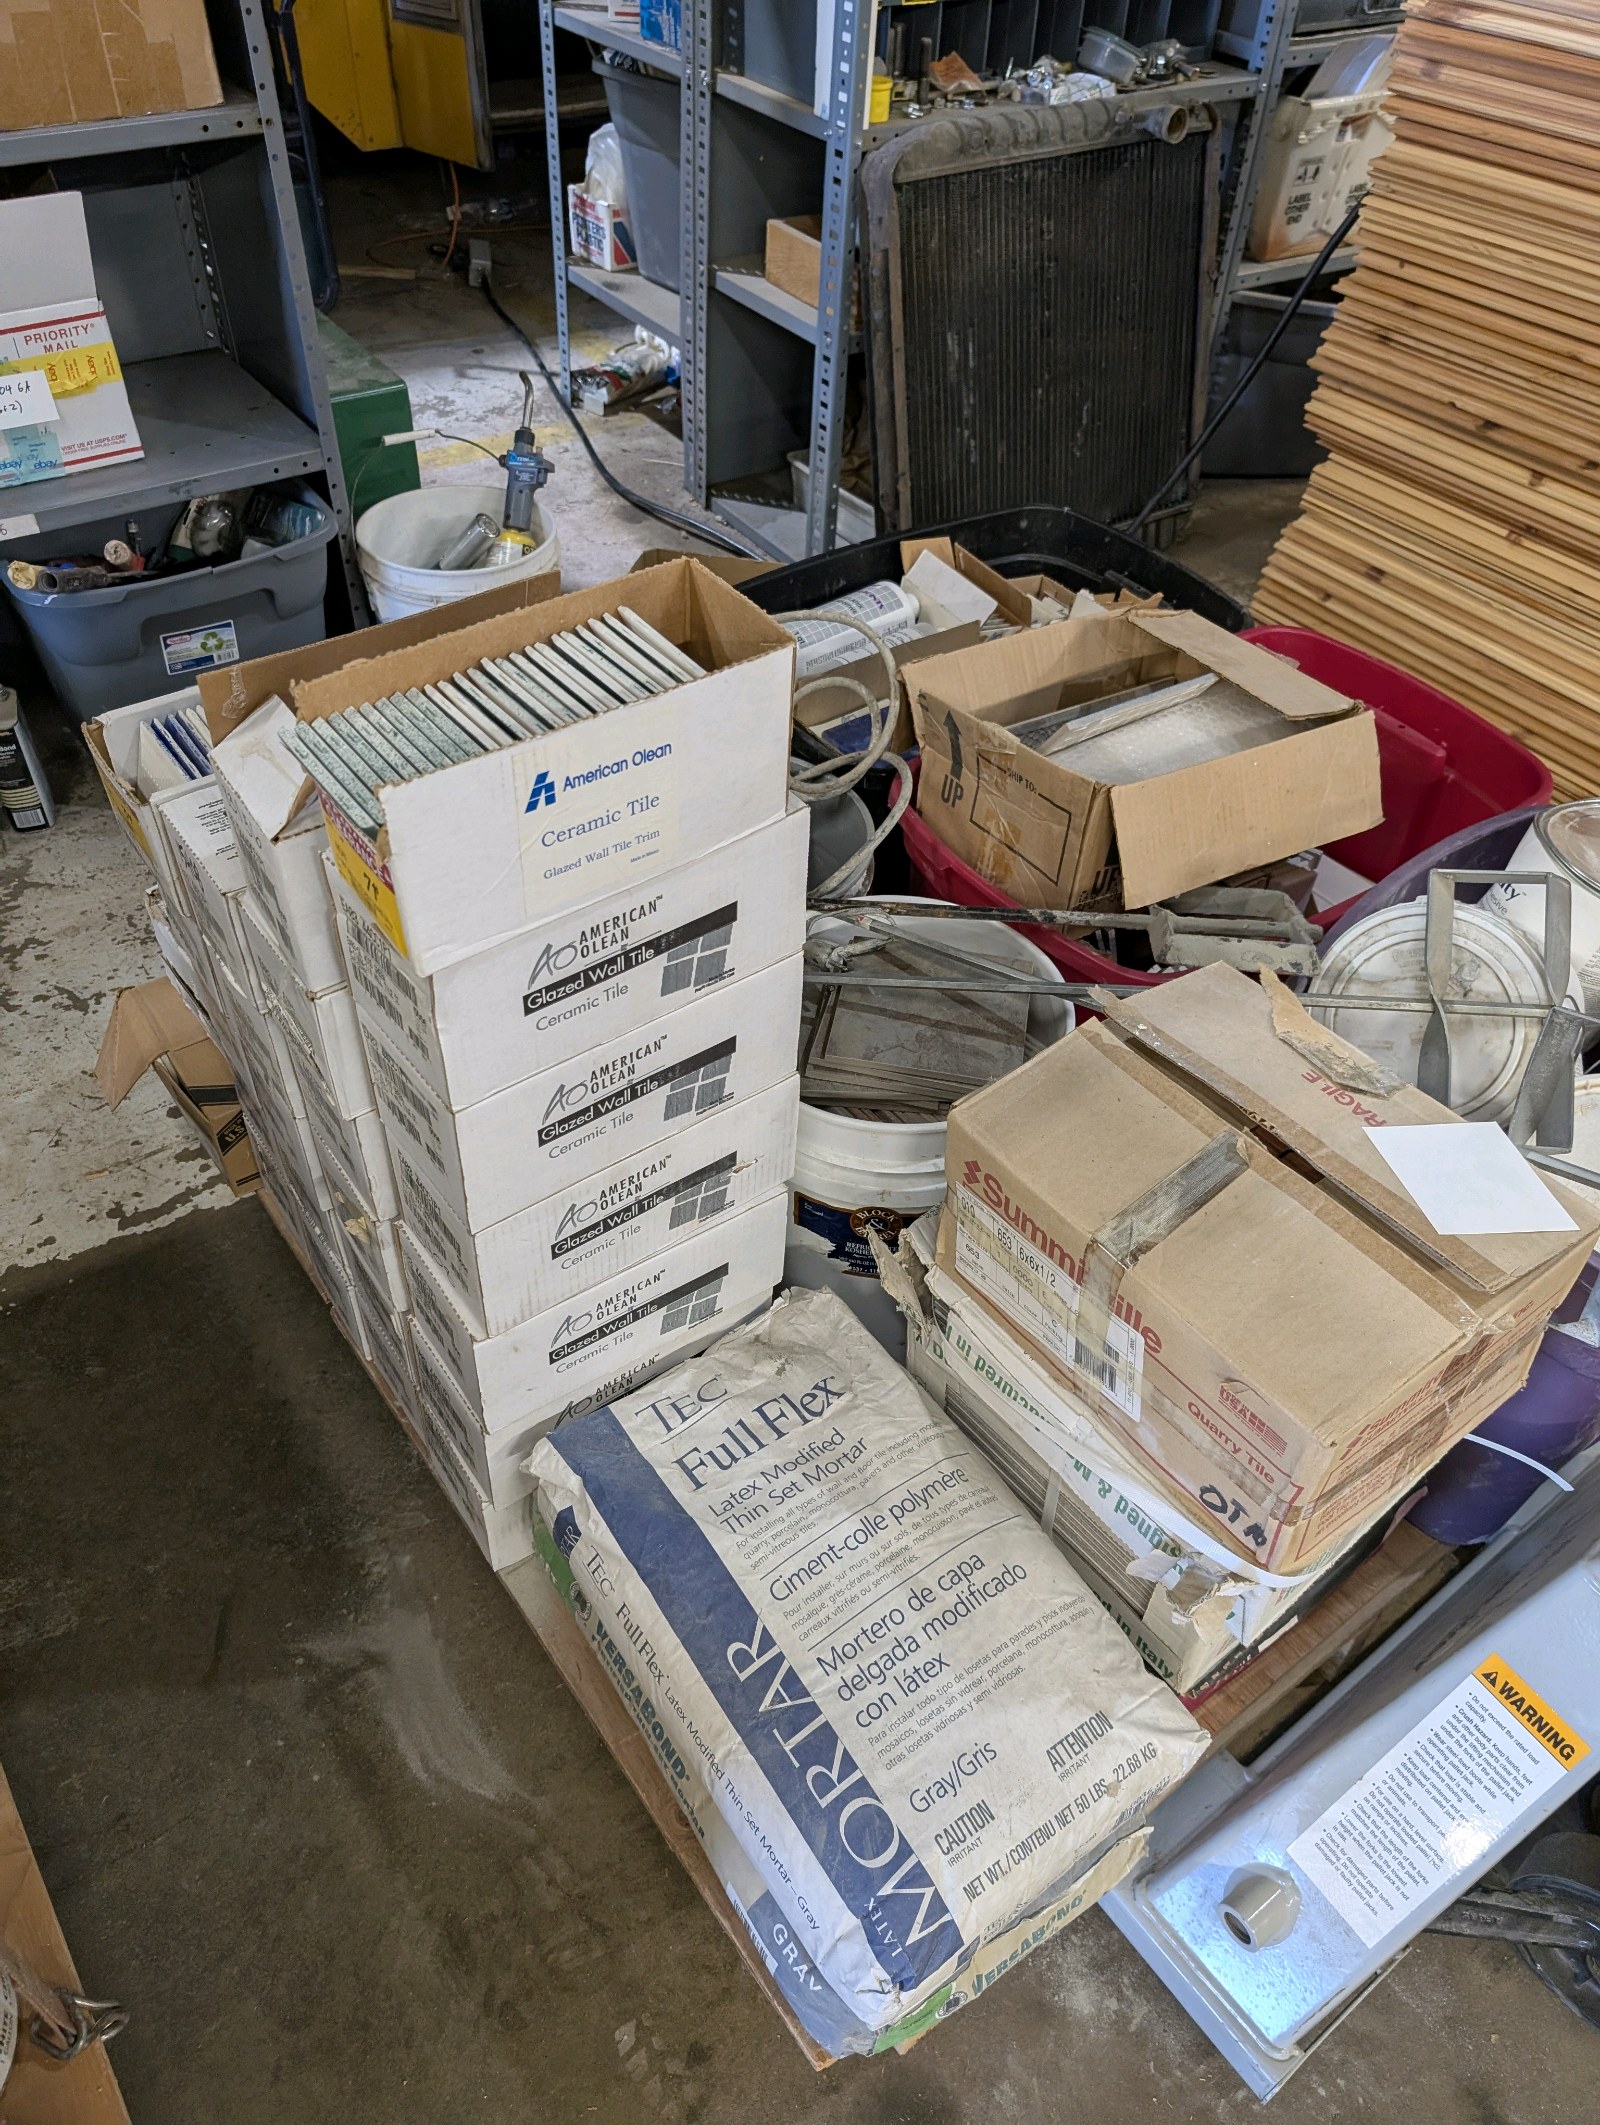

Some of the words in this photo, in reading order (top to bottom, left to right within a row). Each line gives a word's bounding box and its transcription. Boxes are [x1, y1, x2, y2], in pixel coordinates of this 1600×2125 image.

[24, 324, 89, 345] PRIORITY
[43, 340, 78, 353] MAIL
[34, 460, 57, 469] ebay
[563, 757, 628, 792] American
[632, 743, 672, 767] Olean
[941, 774, 964, 808] UP
[541, 809, 622, 847] Ceramic
[627, 795, 660, 816] Tile
[544, 857, 582, 880] Glazed
[585, 848, 609, 864] Wall
[612, 840, 632, 854] Tile
[635, 830, 660, 845] Trim
[579, 899, 657, 945] AMERICAN
[581, 927, 629, 959] OLEAN
[527, 978, 584, 1009] Glazed
[588, 957, 624, 983] Wall
[629, 948, 654, 966] Tile
[535, 998, 600, 1031] Ceramic
[603, 983, 629, 1003] Tile
[590, 1037, 662, 1084] AMERICAN
[591, 1063, 636, 1094] OLEAN
[541, 1109, 594, 1140] Glazed
[598, 1090, 631, 1115] Wall
[635, 1079, 659, 1097] Tile
[1301, 1068, 1388, 1127] RAGILE
[549, 1125, 607, 1159] Ceramic
[610, 1111, 634, 1129] Tile
[599, 1158, 667, 1201] AMERICAN
[600, 1182, 643, 1211] OLEAN
[554, 1225, 604, 1254] Glazed
[607, 1204, 639, 1227] Wall
[642, 1194, 664, 1211] Tile
[856, 1208, 899, 1223] BLOCK
[561, 1237, 616, 1270] Ceramic
[619, 1224, 641, 1241] Tile
[997, 1228, 1012, 1250] 653
[1019, 1246, 1056, 1288] 6x6x1/2
[596, 1272, 661, 1313] AMERICAN
[596, 1294, 637, 1321] OLEAN
[552, 1332, 600, 1360] Glazed
[603, 1313, 634, 1334] Wall
[636, 1303, 658, 1318] Tile
[556, 1343, 609, 1374] Ceramic
[613, 1331, 634, 1347] Tile
[596, 1356, 655, 1395] AMERICAN
[596, 1377, 633, 1403] OLEAN
[636, 1375, 731, 1433] TEC
[1187, 1401, 1242, 1455] Quarry
[1245, 1451, 1275, 1485] Tile
[709, 1481, 762, 1516] Latex
[762, 1428, 844, 1483] Modified
[720, 1505, 768, 1532] Thin
[769, 1481, 804, 1505] Set
[802, 1438, 866, 1485] Mortar
[736, 1538, 748, 1549] For
[750, 1516, 785, 1539] installing
[786, 1508, 795, 1517] all
[796, 1497, 816, 1511] types
[817, 1489, 825, 1498] of
[826, 1480, 842, 1492] wall
[843, 1472, 857, 1482] and
[858, 1458, 873, 1474] floor
[874, 1451, 886, 1459] tile
[886, 1432, 919, 1452] including
[744, 1540, 770, 1559] quarry,
[771, 1517, 807, 1541] porcelain,
[859, 1467, 881, 1487] pavers
[882, 1456, 895, 1468] and
[897, 1447, 915, 1459] other
[748, 1532, 799, 1570] semi-vitreous
[800, 1522, 818, 1533] tiles.
[763, 1516, 887, 1600] Ciment-colle
[889, 1469, 968, 1524] polymère
[817, 1609, 904, 1675] Mortero
[908, 1588, 936, 1611] de
[938, 1555, 984, 1590] capa
[838, 1636, 919, 1700] delgada
[923, 1565, 1026, 1639] modificado
[1135, 1630, 1175, 1680] Italy
[588, 1618, 692, 1782] VERSABOND
[856, 1693, 896, 1727] con
[894, 1654, 949, 1696] látex
[1466, 1702, 1486, 1722] capacity.
[587, 1546, 614, 1596] TEC
[665, 1688, 686, 1722] Latex
[687, 1722, 724, 1779] Modified
[726, 1779, 742, 1810] Thin
[744, 1812, 759, 1835] Set
[760, 1836, 790, 1882] Mortar
[798, 1896, 819, 1929] Gray
[1047, 1711, 1112, 1772] ATTENTION
[1459, 1709, 1473, 1724] Crush
[1473, 1724, 1491, 1743] Hazard.
[1492, 1743, 1505, 1757] Keep
[1505, 1756, 1520, 1774] hands,
[1521, 1774, 1532, 1785] feet
[1472, 1696, 1479, 1704] Do
[1479, 1704, 1488, 1712] not
[1488, 1713, 1506, 1730] exceed
[1505, 1730, 1514, 1739] the
[1514, 1740, 1528, 1752] rated
[1527, 1752, 1539, 1764] load
[1500, 1682, 1574, 1759] WARNING
[726, 1610, 954, 1949] MORTAR
[910, 1744, 996, 1812] Gray/Gris
[1058, 1753, 1089, 1781] IRRITANT
[935, 1800, 994, 1854] CAUTION
[963, 1875, 985, 1902] NET
[1054, 1804, 1074, 1829] NET
[1074, 1794, 1090, 1813] 50
[1113, 1754, 1141, 1783] 22.68
[1140, 1742, 1156, 1762] KG
[948, 1836, 982, 1866] IRRITANT
[863, 1897, 902, 1957] LATEX
[773, 1923, 822, 1992] GRAY
